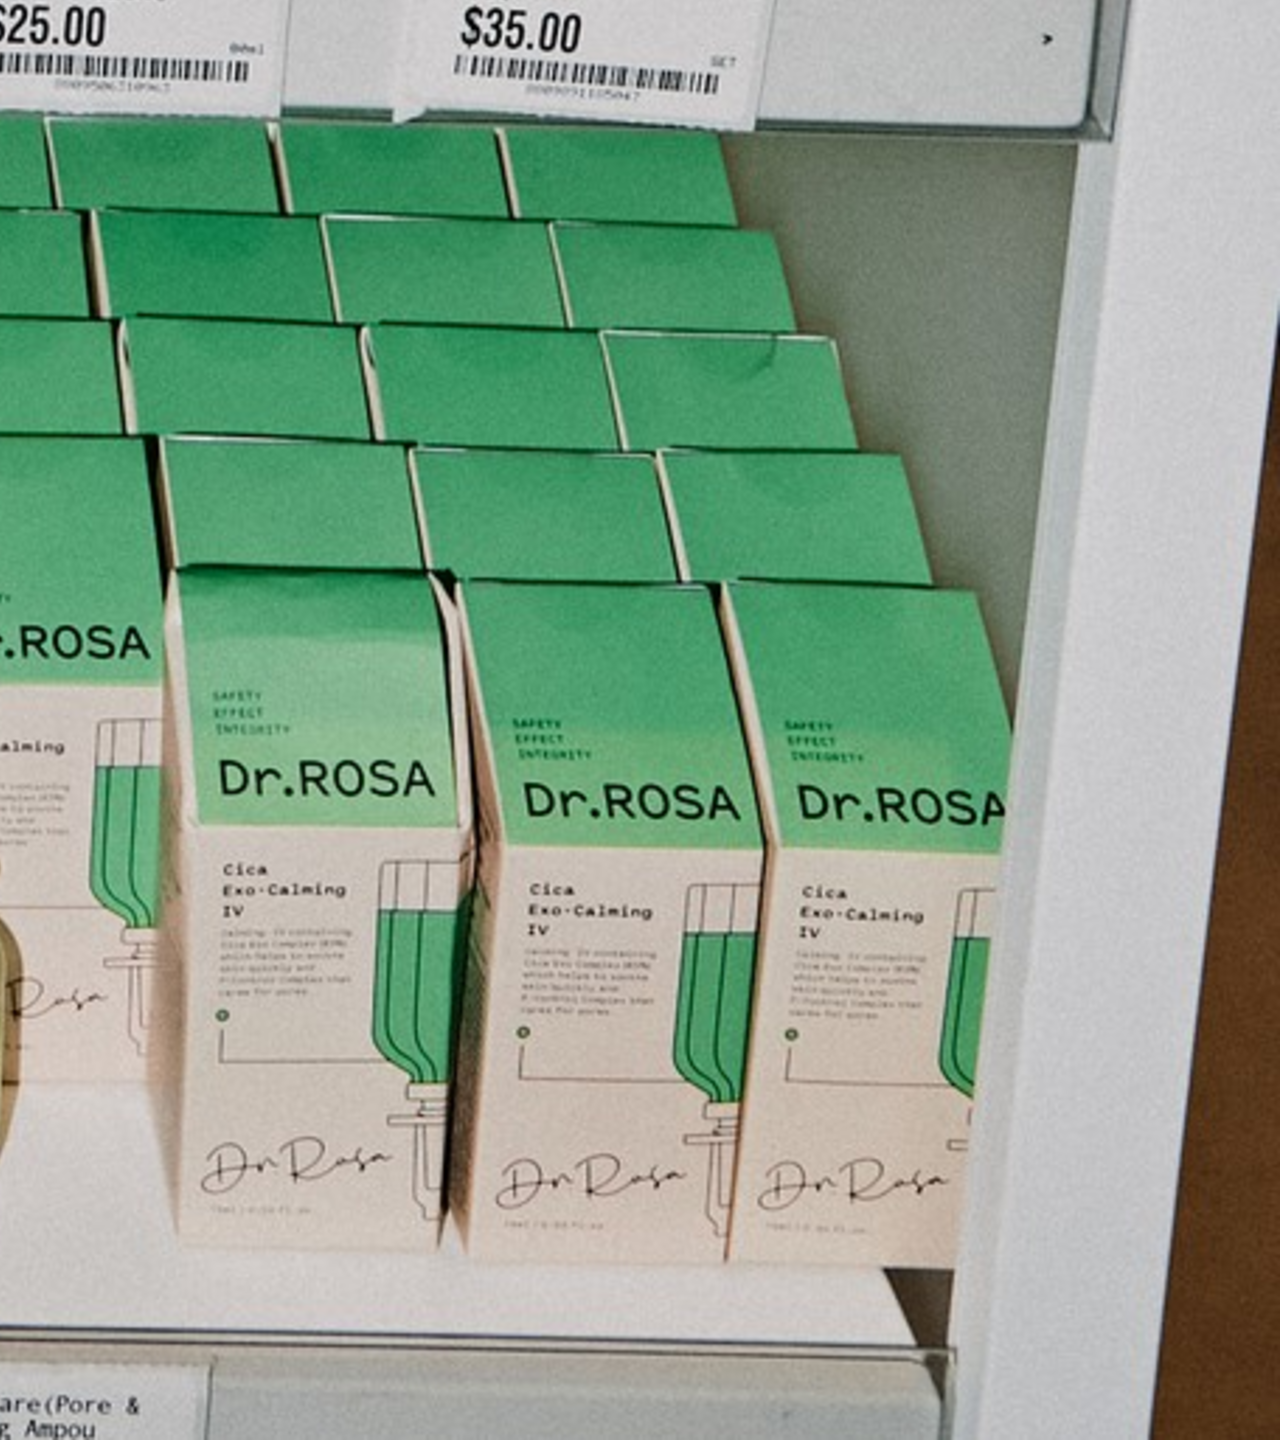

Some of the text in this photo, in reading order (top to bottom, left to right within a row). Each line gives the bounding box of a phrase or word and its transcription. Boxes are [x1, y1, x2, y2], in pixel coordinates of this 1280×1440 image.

[460, 5, 582, 54] $35.00
[218, 758, 437, 800] Dr.ROSA
[523, 782, 742, 823] Dr.ROSA
[222, 862, 269, 878] Cica
